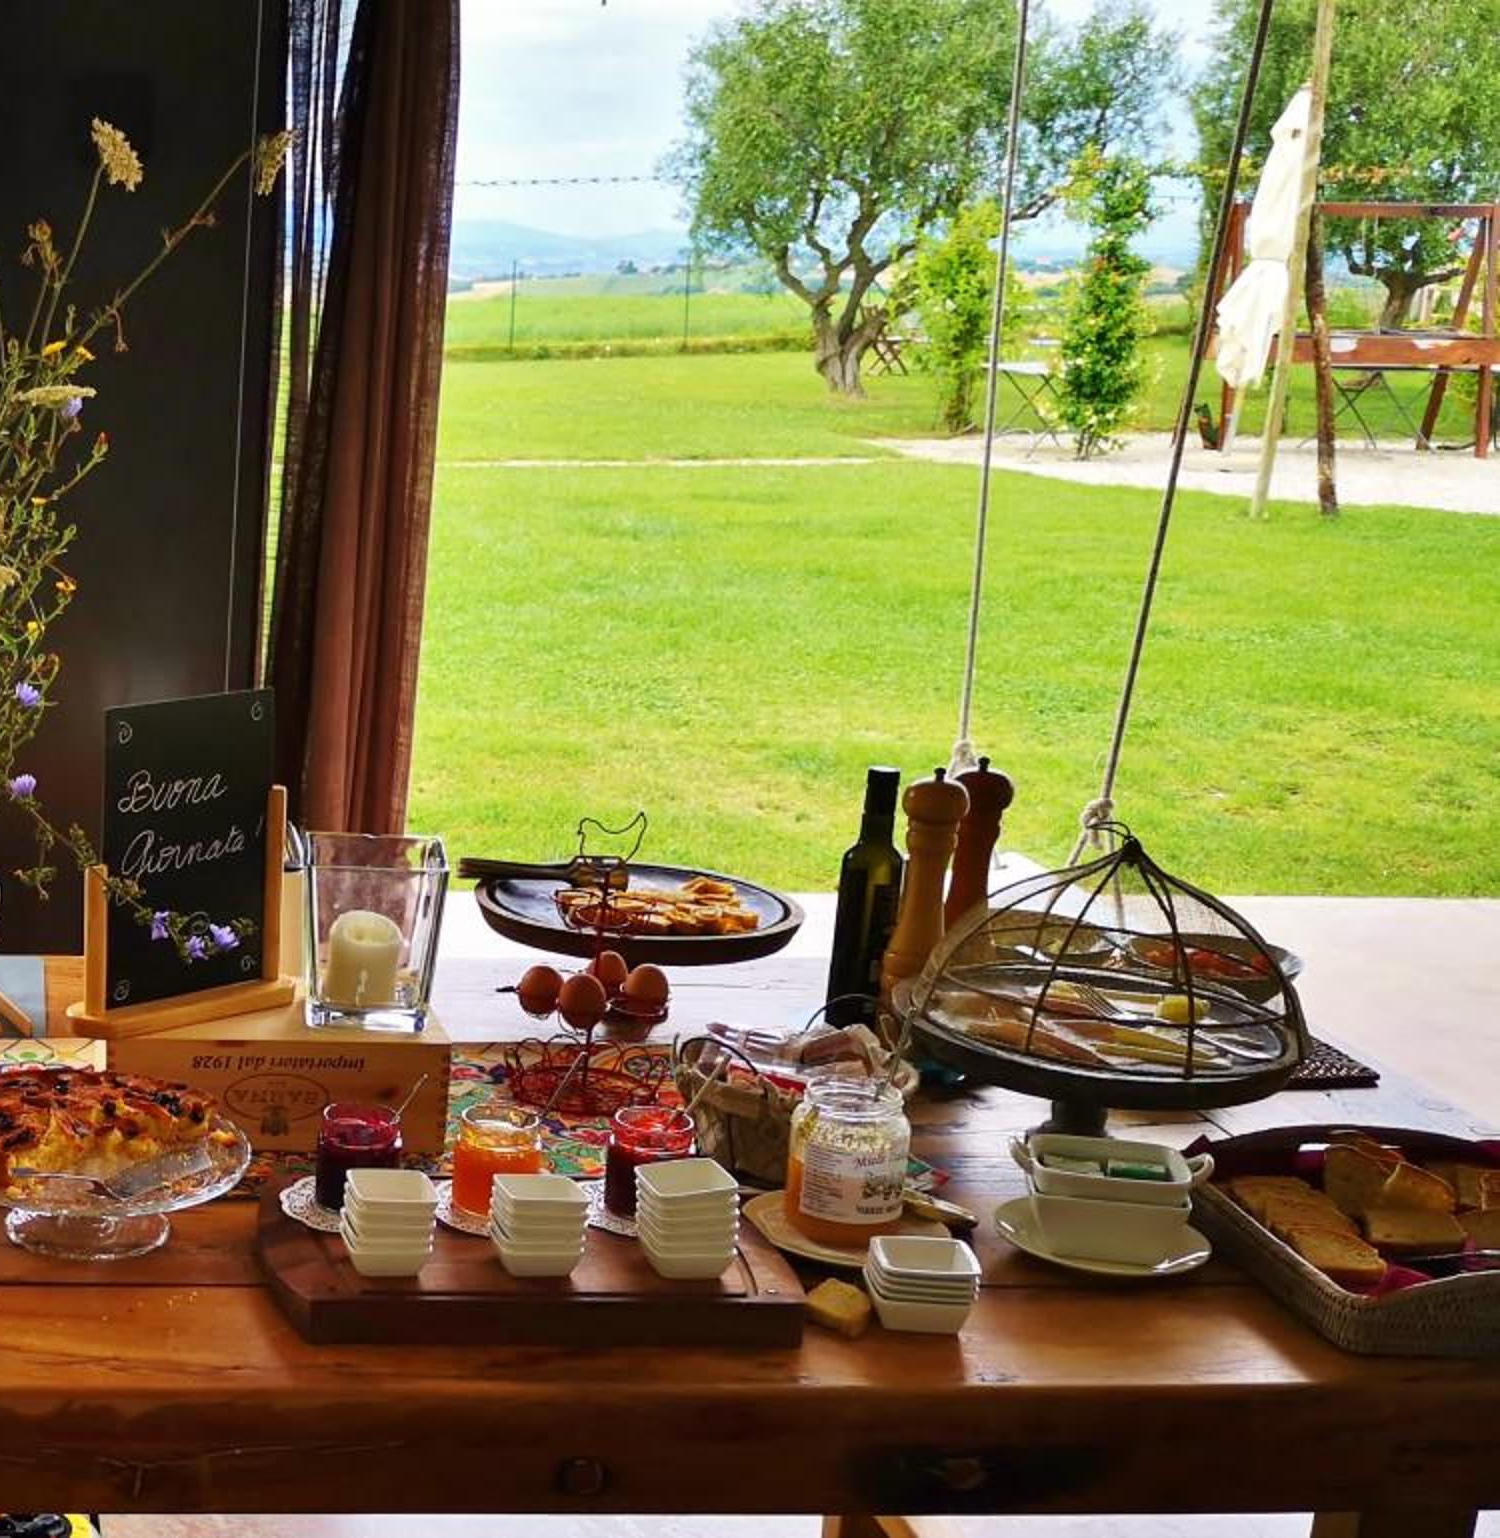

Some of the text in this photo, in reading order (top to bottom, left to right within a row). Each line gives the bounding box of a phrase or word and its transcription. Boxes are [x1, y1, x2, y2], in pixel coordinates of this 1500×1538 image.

[118, 769, 228, 814] Buona
[191, 1055, 232, 1071] 1928
[238, 1056, 266, 1072] dal
